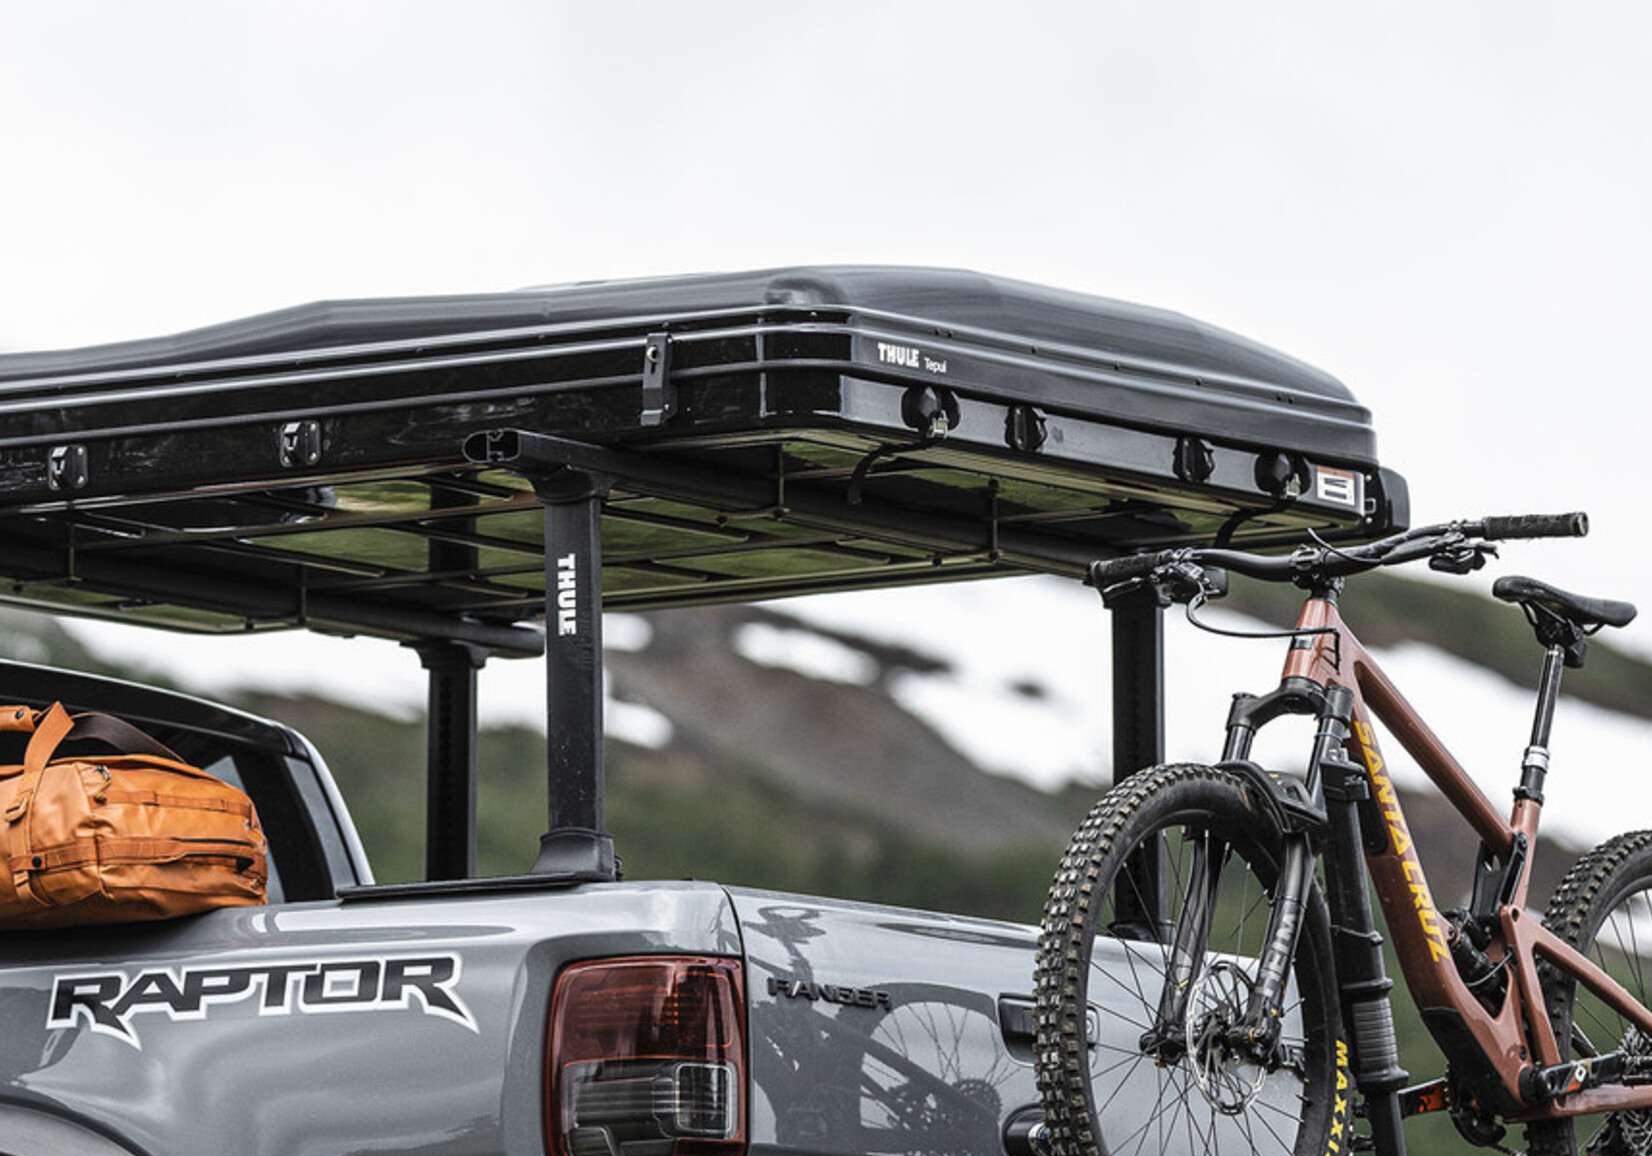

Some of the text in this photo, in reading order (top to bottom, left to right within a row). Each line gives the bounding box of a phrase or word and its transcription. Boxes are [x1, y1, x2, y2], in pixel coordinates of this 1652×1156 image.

[877, 341, 920, 369] THULE
[557, 552, 577, 636] THULE
[1354, 721, 1450, 963] SANTA CRUZ
[45, 950, 481, 1052] RAPTOR
[767, 976, 893, 1011] RANGER
